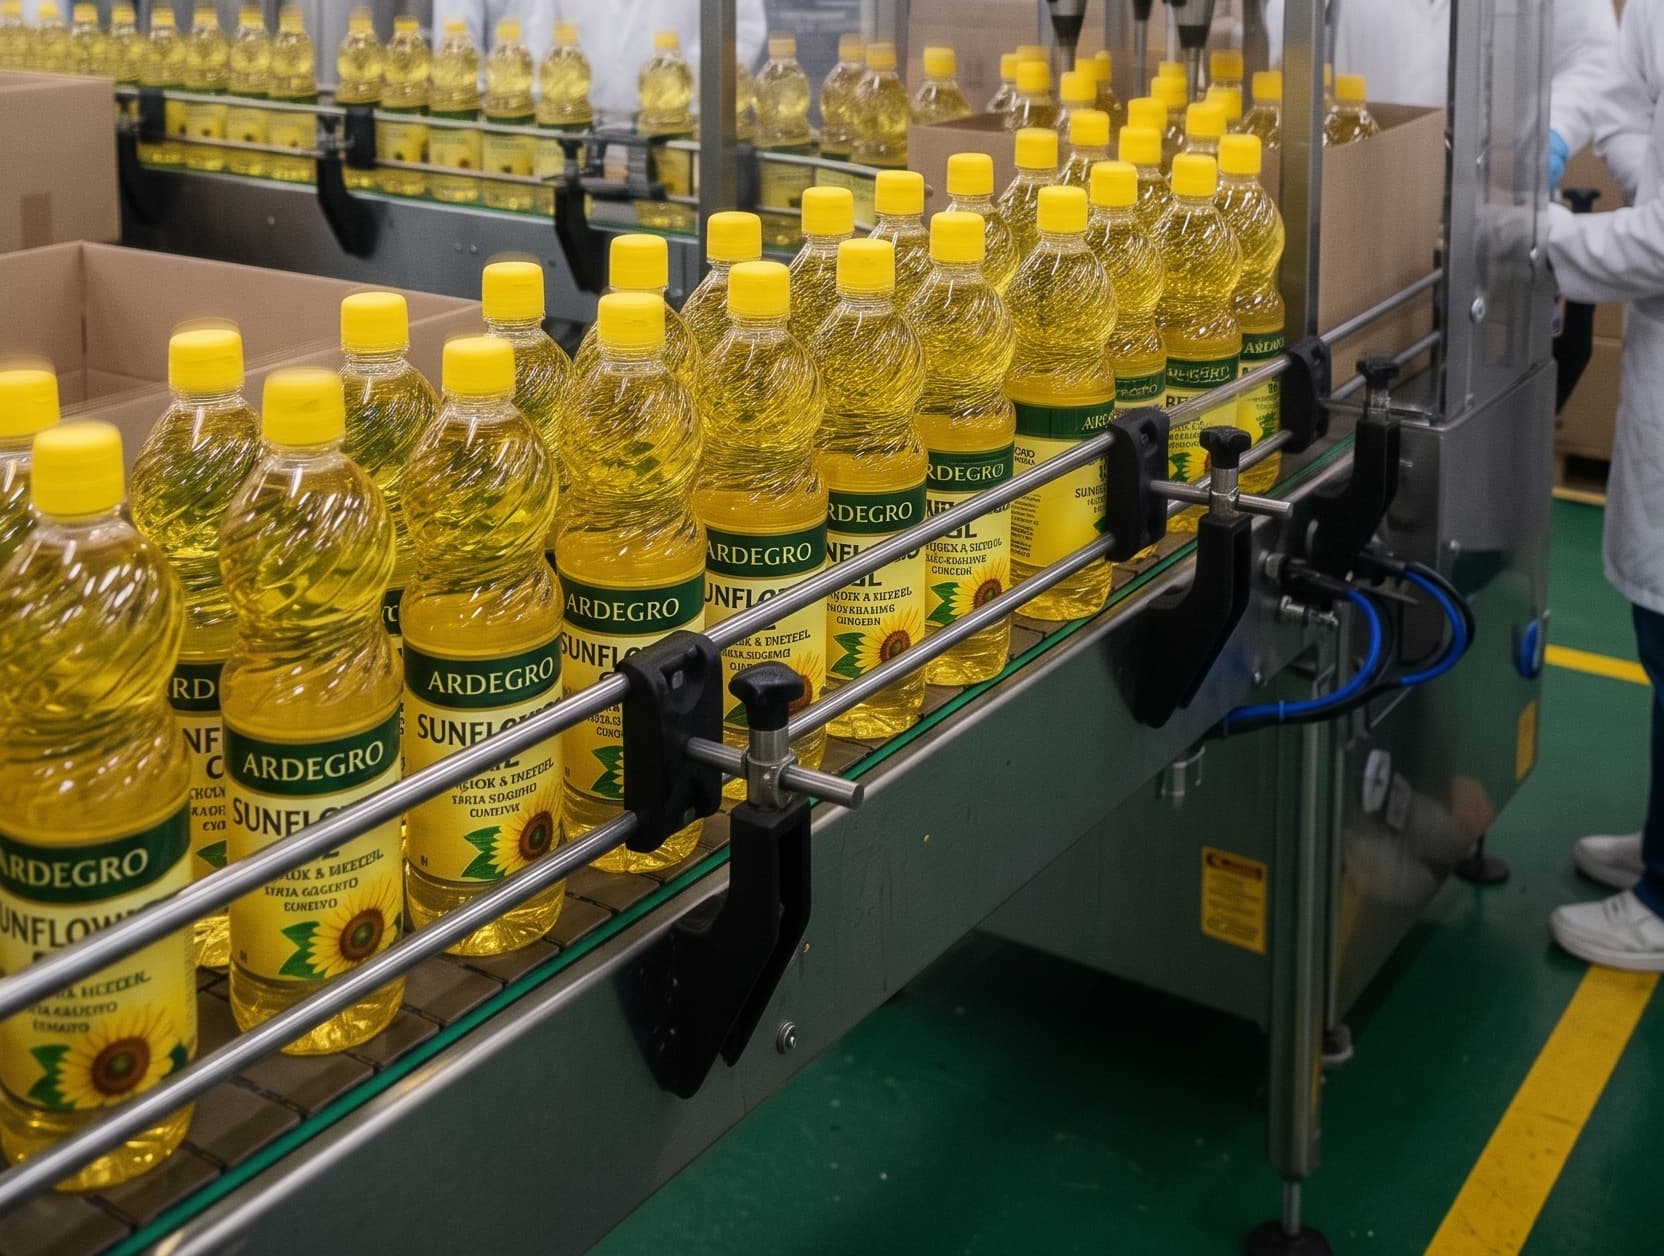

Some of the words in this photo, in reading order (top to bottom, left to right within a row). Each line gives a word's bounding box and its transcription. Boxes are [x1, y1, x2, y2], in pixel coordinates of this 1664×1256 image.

[926, 464, 1004, 482] RDEGRO
[828, 501, 913, 523] RDEGRO
[566, 592, 680, 622] ARDEGRO
[428, 656, 554, 695] ARDEGRO
[243, 740, 384, 782] ARDEGRO
